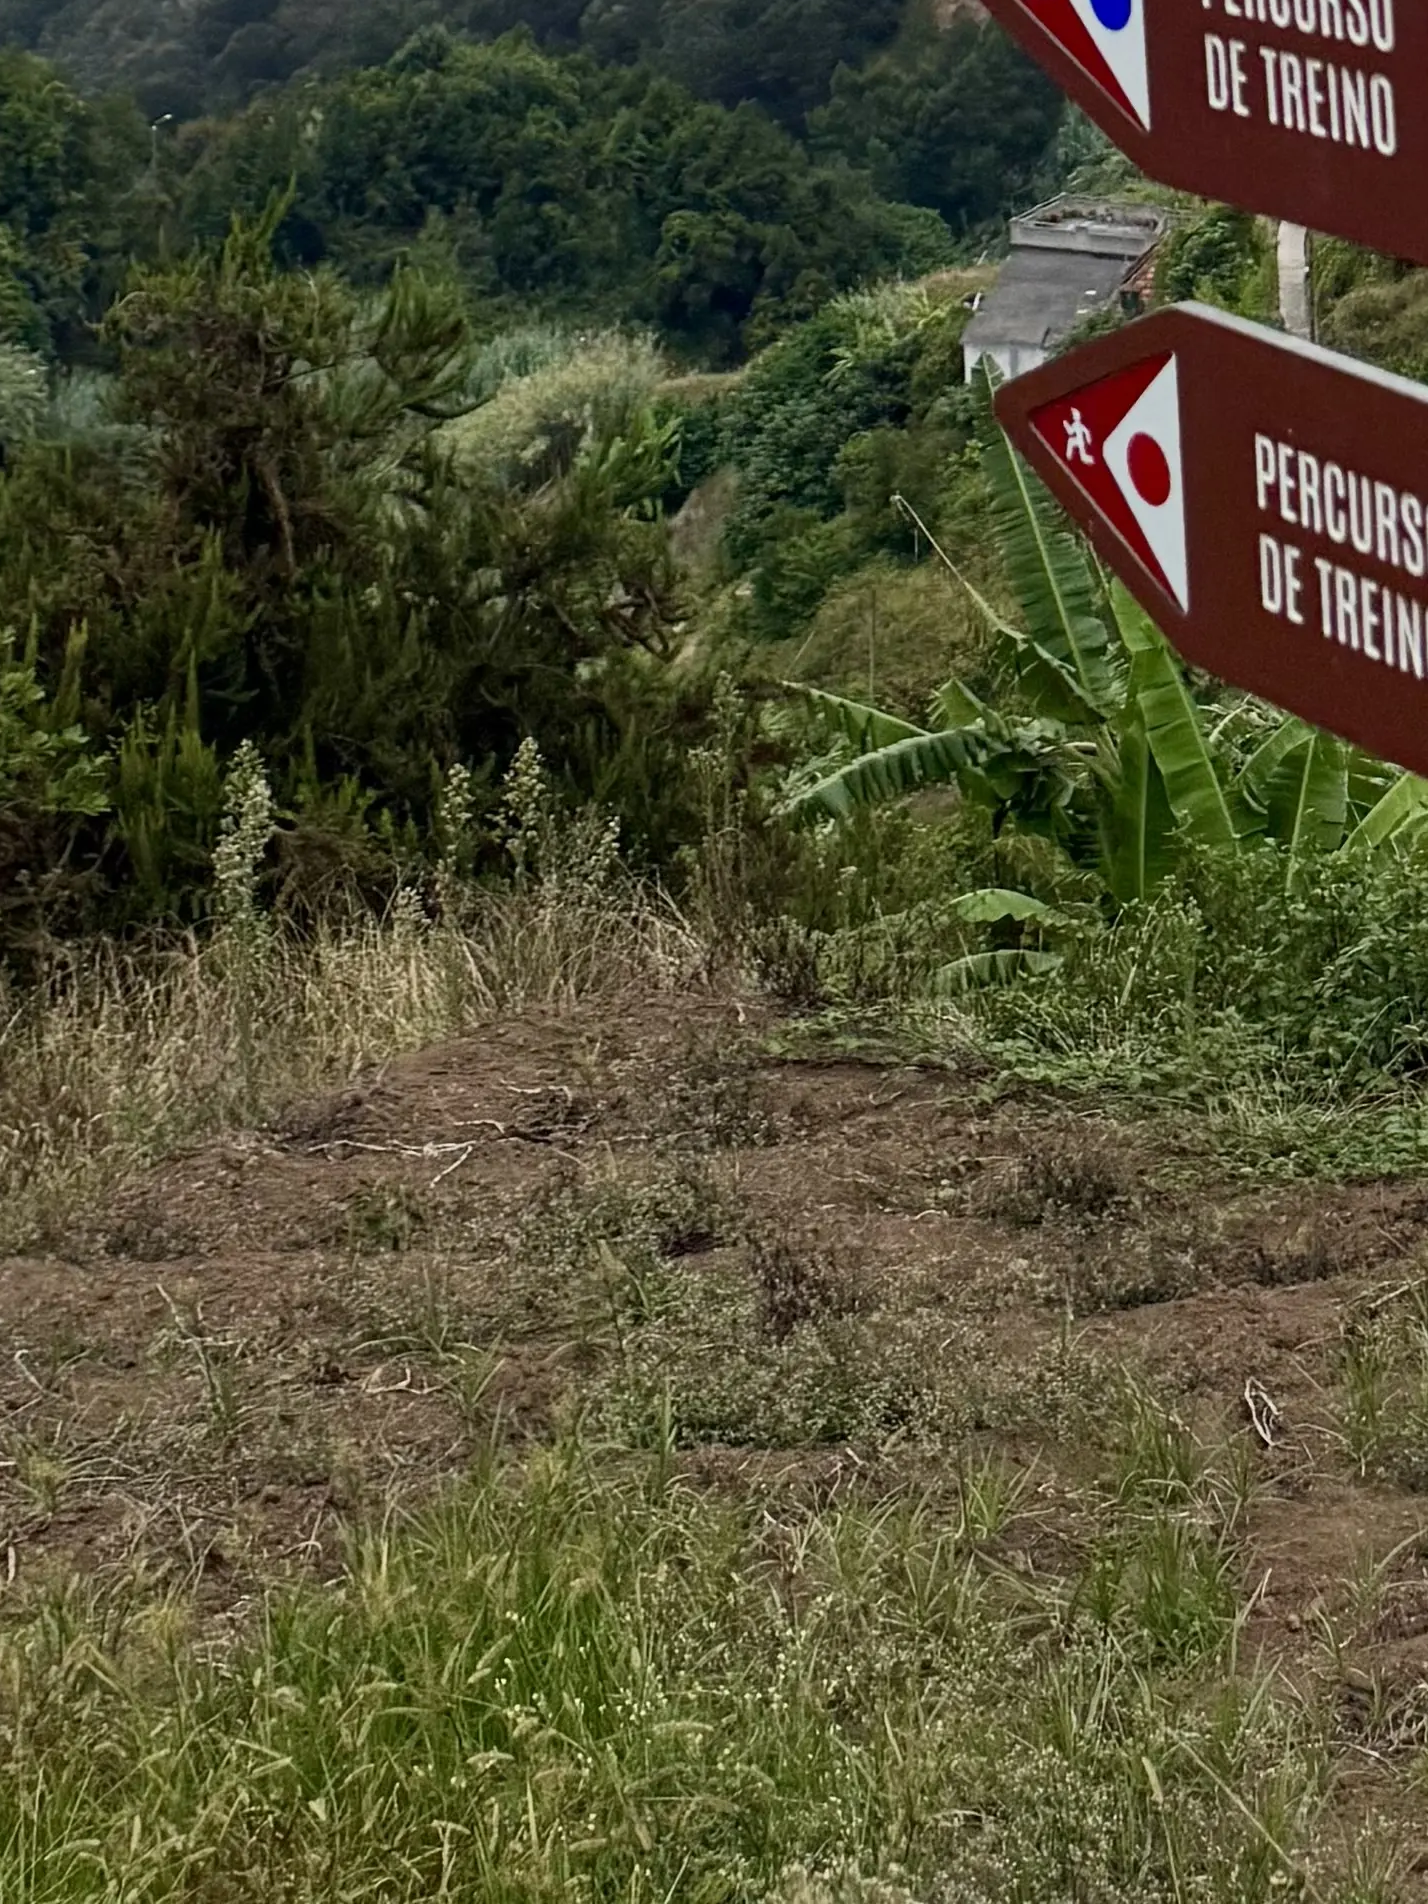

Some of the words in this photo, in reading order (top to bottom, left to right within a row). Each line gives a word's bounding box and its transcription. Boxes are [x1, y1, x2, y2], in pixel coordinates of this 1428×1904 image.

[1204, 33, 1250, 117] DE
[1259, 45, 1398, 156] TREINO
[1259, 534, 1305, 625] DE
